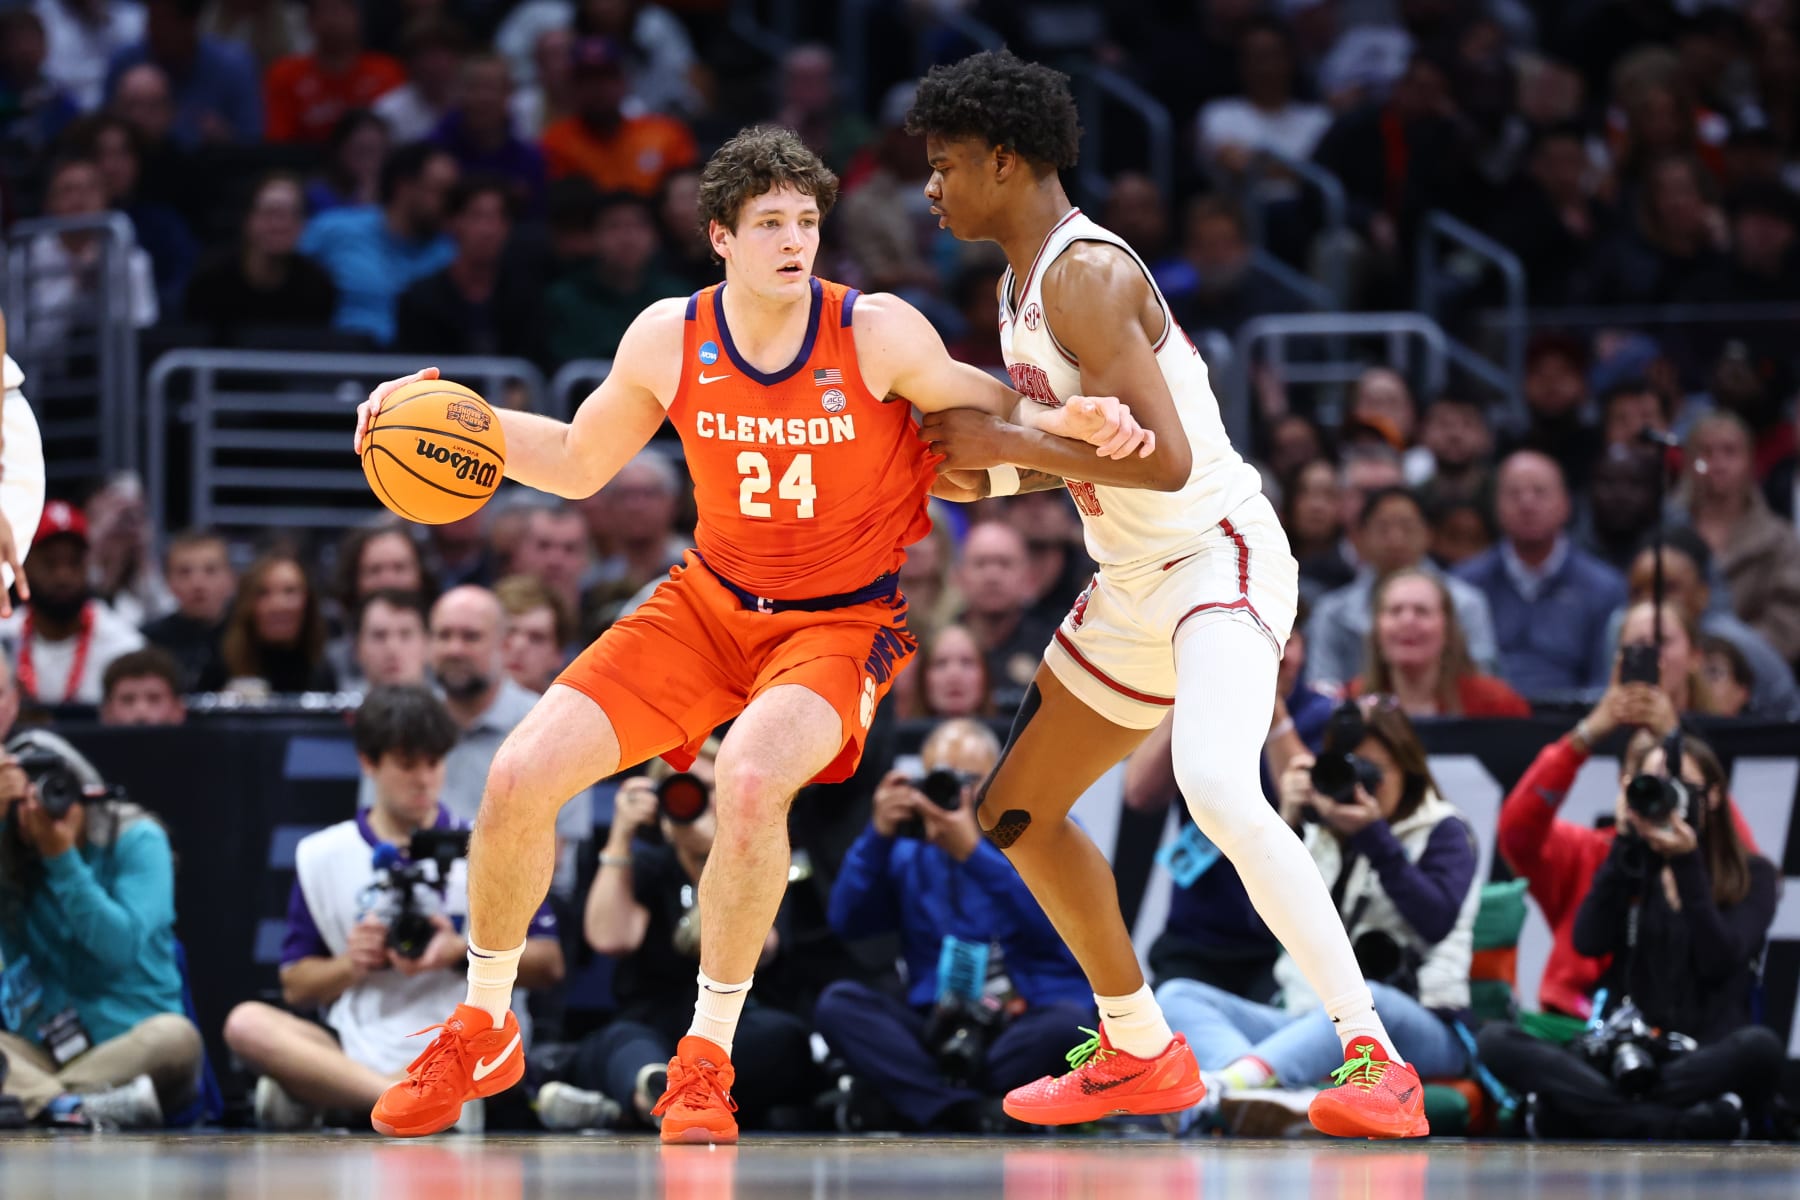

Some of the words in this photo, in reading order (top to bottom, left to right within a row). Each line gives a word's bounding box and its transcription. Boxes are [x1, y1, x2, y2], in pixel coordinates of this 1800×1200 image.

[827, 396, 843, 404] ACC
[696, 410, 856, 446] CLEMSON
[416, 438, 497, 488] Wilson
[736, 451, 817, 519] 24
